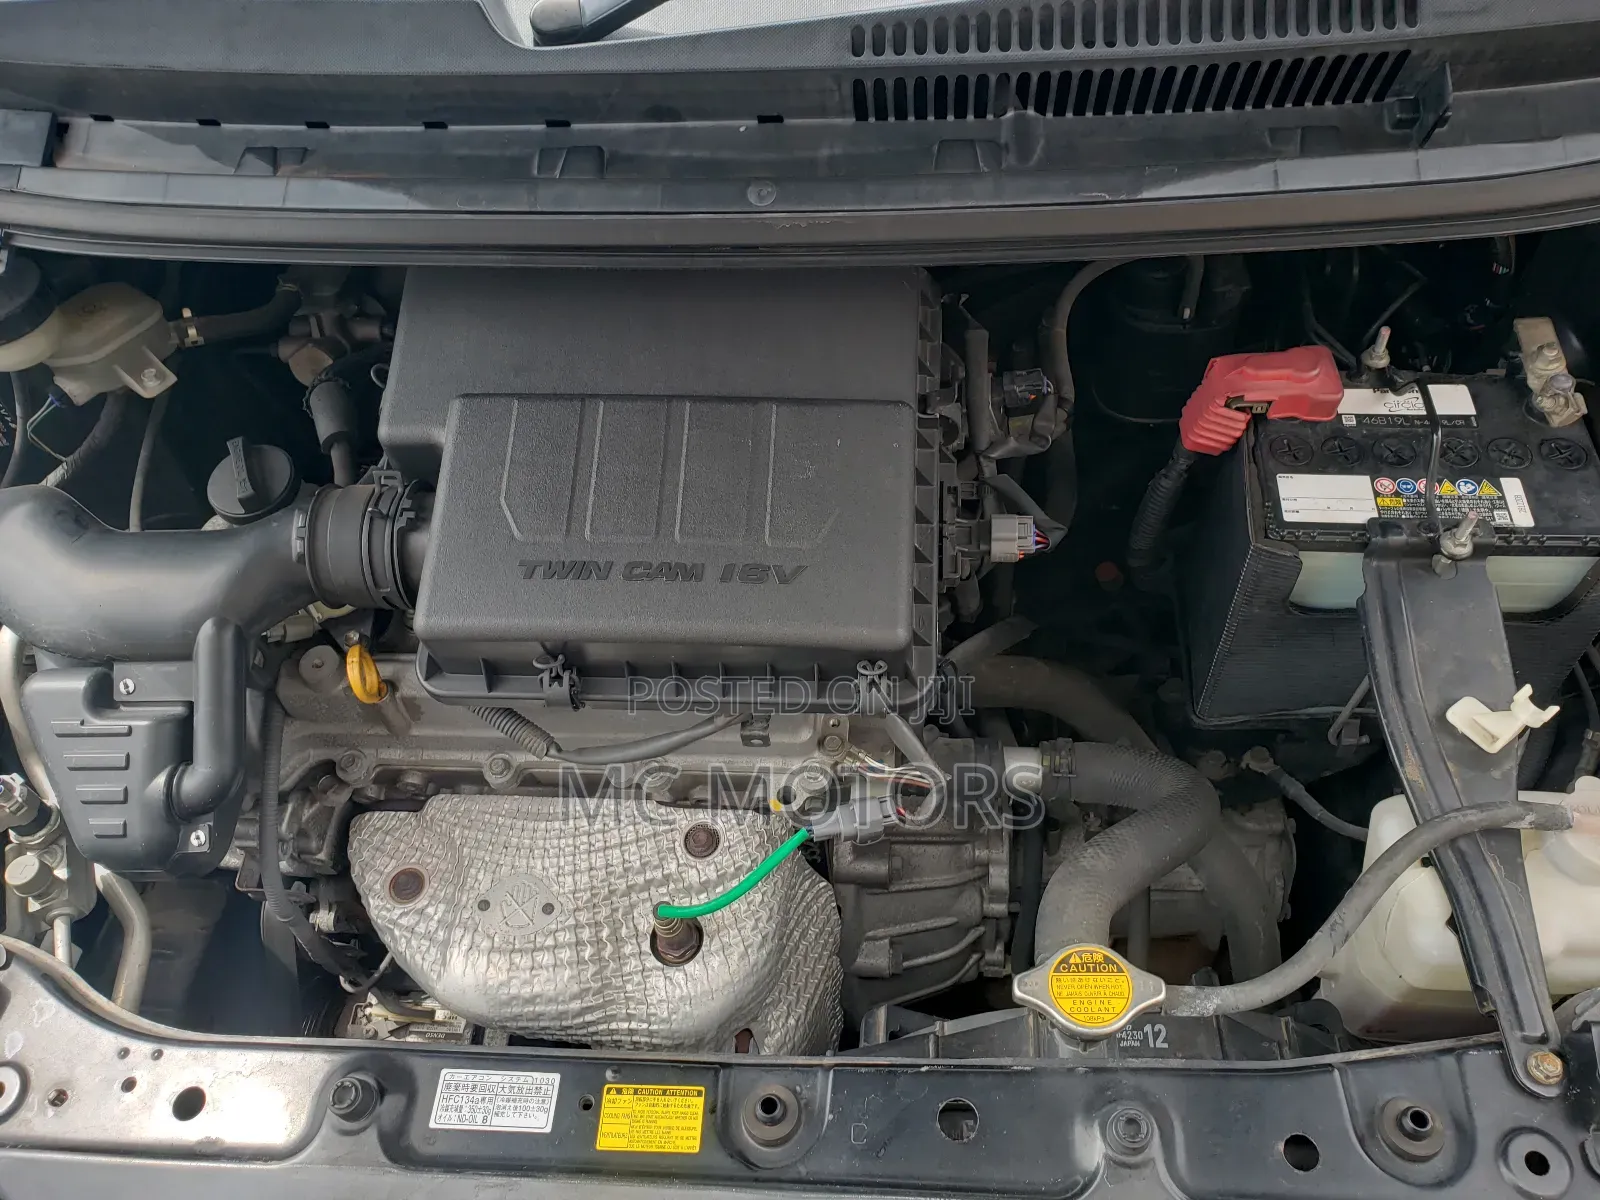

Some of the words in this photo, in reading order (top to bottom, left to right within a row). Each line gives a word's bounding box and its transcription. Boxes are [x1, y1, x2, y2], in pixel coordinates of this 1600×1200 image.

[1362, 416, 1411, 426] 46B19L
[517, 559, 614, 581] TWIN
[620, 560, 706, 583] CAM
[718, 562, 809, 585] 16V
[1081, 952, 1105, 963] 危険
[1059, 963, 1118, 973] CAUTION
[1143, 1023, 1169, 1049] 12
[1119, 1039, 1141, 1047] JAPAN
[448, 1073, 493, 1081] カーエアコン
[534, 1077, 556, 1085] 1030
[637, 1088, 663, 1096] CAUTION
[665, 1089, 698, 1097] ATTENTION
